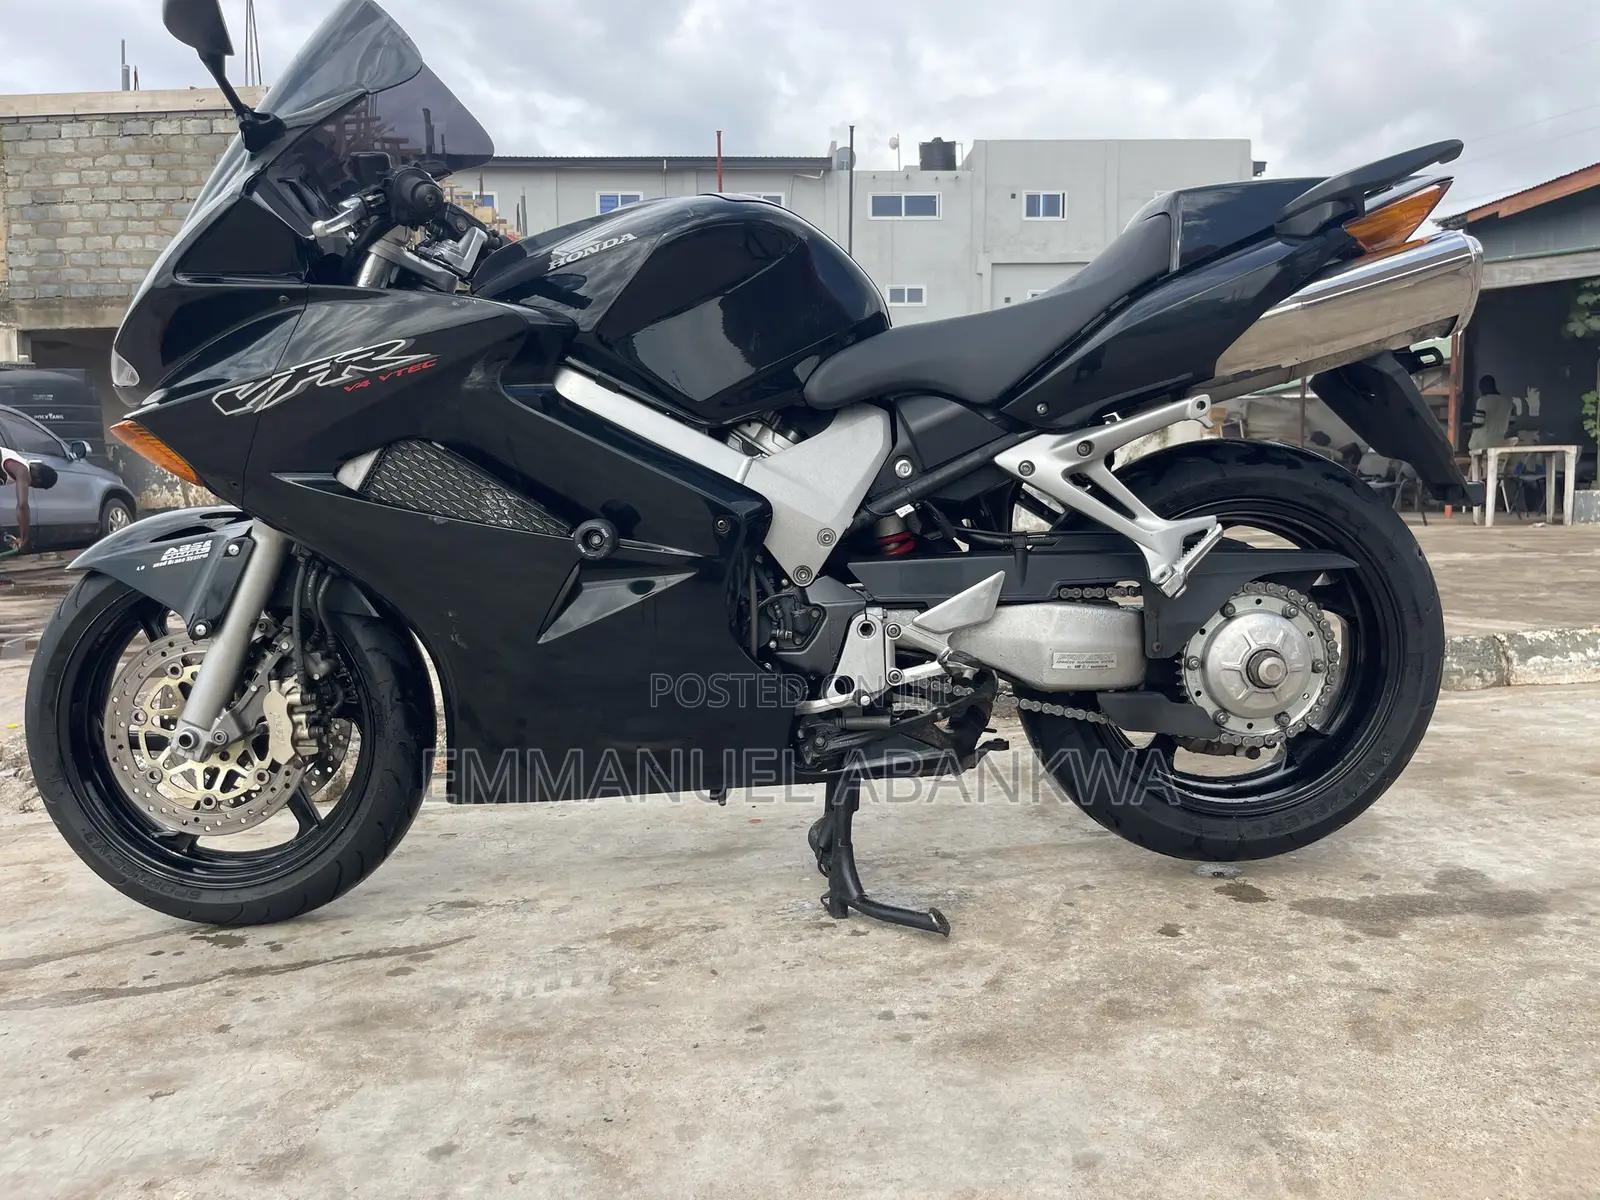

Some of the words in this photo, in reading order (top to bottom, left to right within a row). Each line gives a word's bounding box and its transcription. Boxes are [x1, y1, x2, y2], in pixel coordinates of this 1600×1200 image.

[547, 233, 638, 271] HONDA
[212, 339, 434, 416] VFR
[343, 379, 371, 393] V4
[378, 358, 438, 381] VTEC
